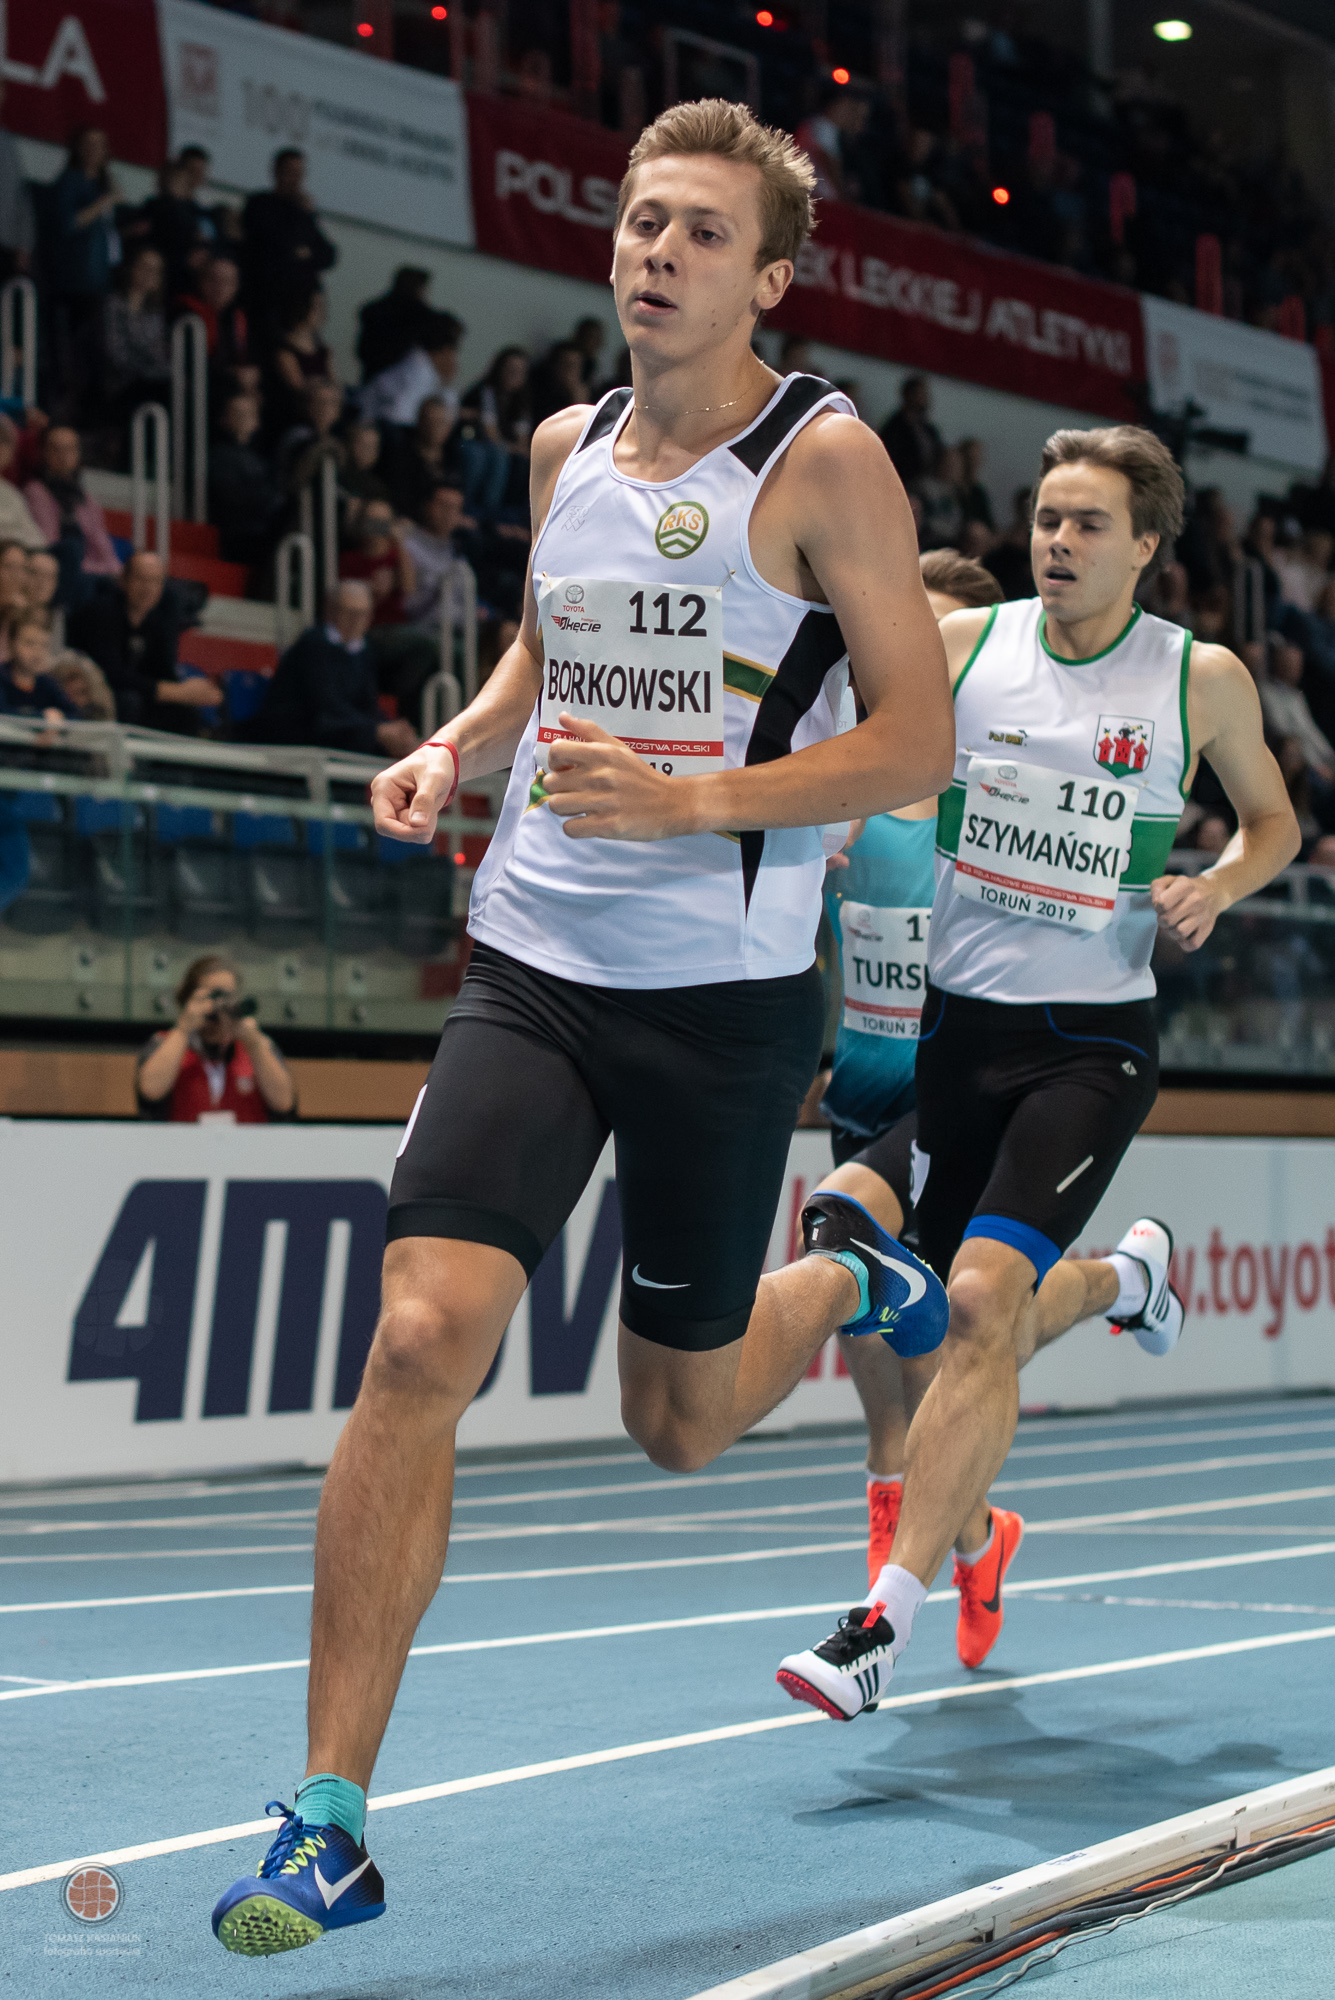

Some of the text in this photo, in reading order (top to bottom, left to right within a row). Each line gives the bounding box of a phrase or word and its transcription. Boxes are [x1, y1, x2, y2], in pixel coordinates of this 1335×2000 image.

[496, 149, 619, 229] POLS
[795, 242, 840, 296] EK
[663, 509, 702, 531] RKS
[562, 605, 585, 613] TOYOTA
[628, 590, 707, 638] 112
[547, 658, 712, 714] BORKOWSKI
[626, 741, 671, 752] RZOSTWA
[672, 744, 710, 753] POLSKI
[649, 762, 673, 776] 19
[1056, 780, 1127, 822] 110
[964, 813, 1121, 879] SZYMAŃSKI
[980, 885, 1077, 922] TORUŃ 2019
[906, 913, 931, 942] 1
[862, 1016, 906, 1035] TORUŃ
